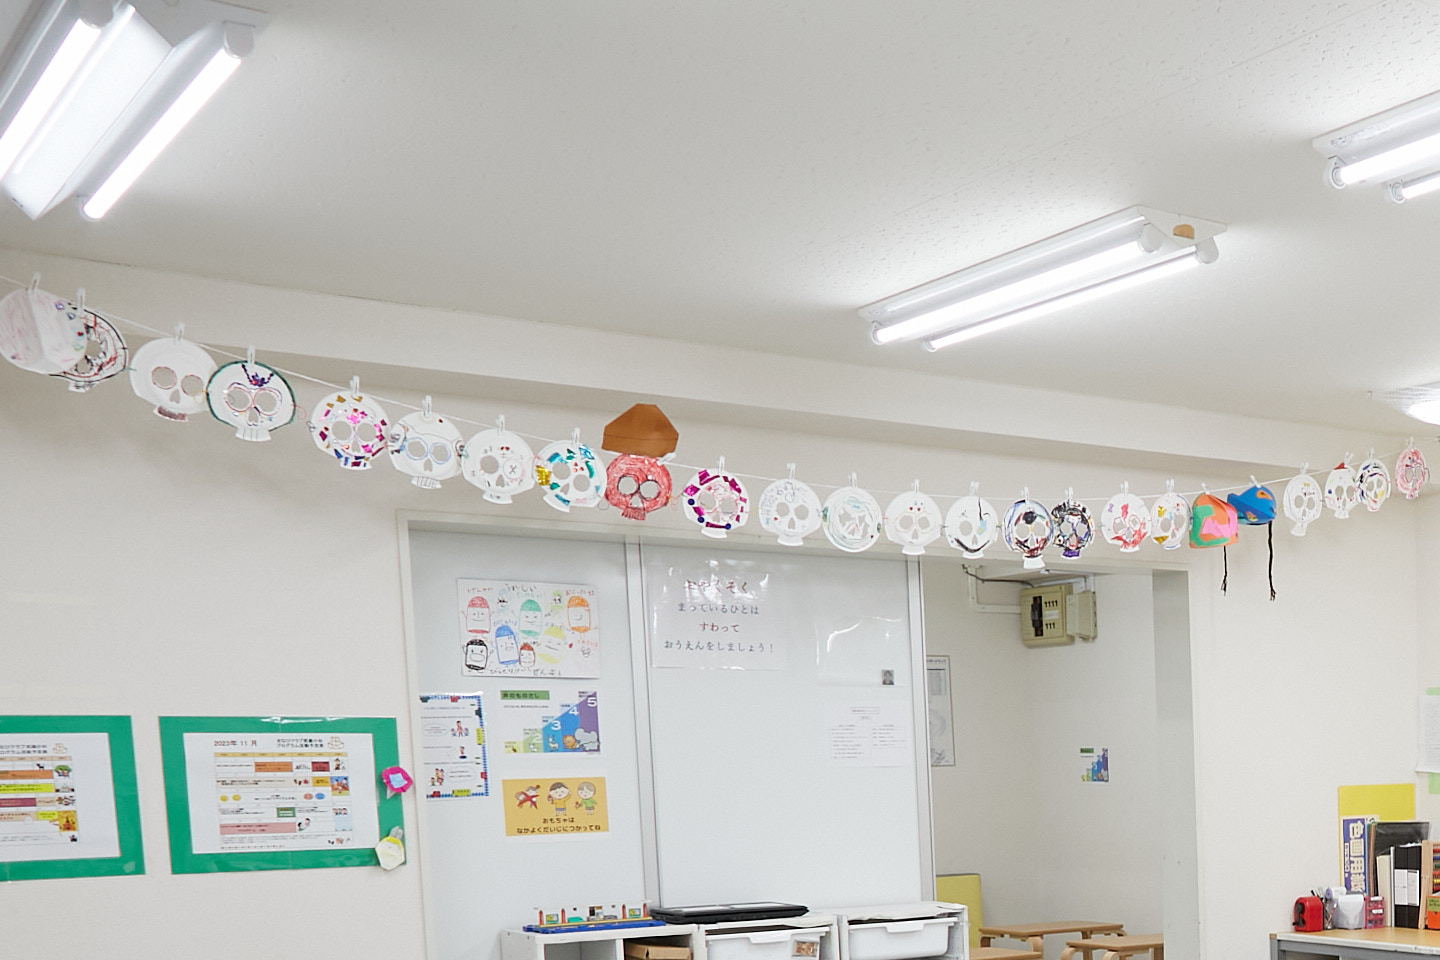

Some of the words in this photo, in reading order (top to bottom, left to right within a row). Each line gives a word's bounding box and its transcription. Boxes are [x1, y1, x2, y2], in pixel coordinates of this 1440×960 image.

[678, 602, 760, 615] まっているひとは
[699, 621, 740, 633] すわって
[664, 640, 774, 653] おうえんをしましょう！
[587, 697, 598, 707] 5
[568, 706, 580, 716] 4
[550, 720, 561, 731] 3
[516, 824, 601, 834] なかよくだいじにつかってね
